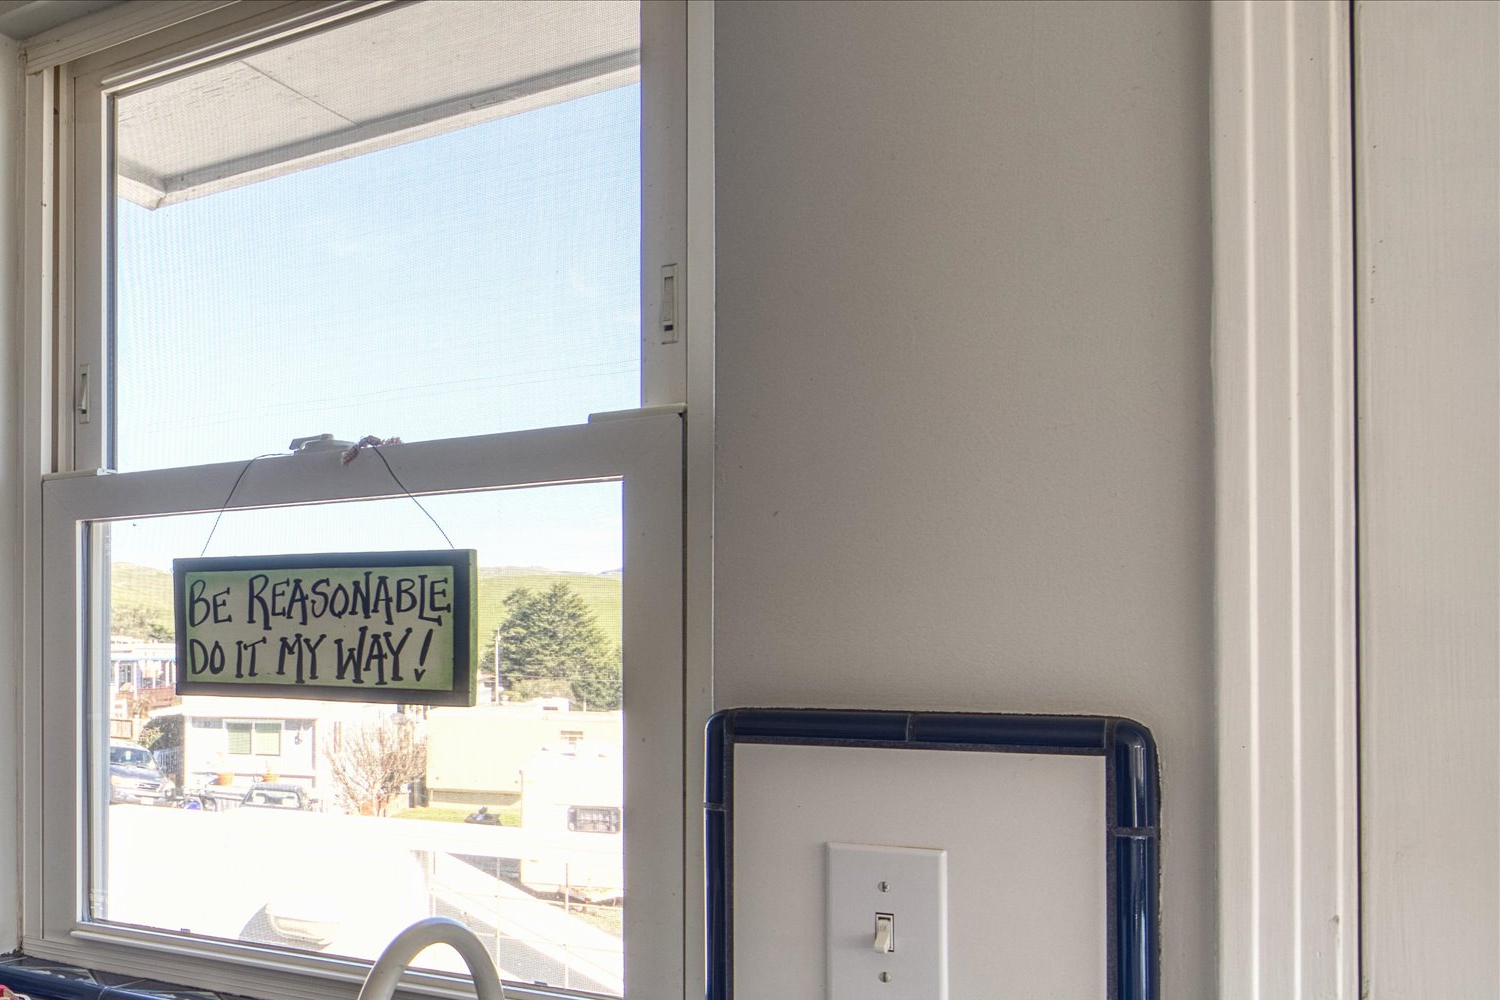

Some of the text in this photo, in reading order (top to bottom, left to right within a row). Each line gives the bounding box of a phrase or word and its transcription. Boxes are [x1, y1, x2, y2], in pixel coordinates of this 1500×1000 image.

[189, 571, 451, 631] BE REASONABLE
[189, 625, 434, 685] DO IT MY WAY!
